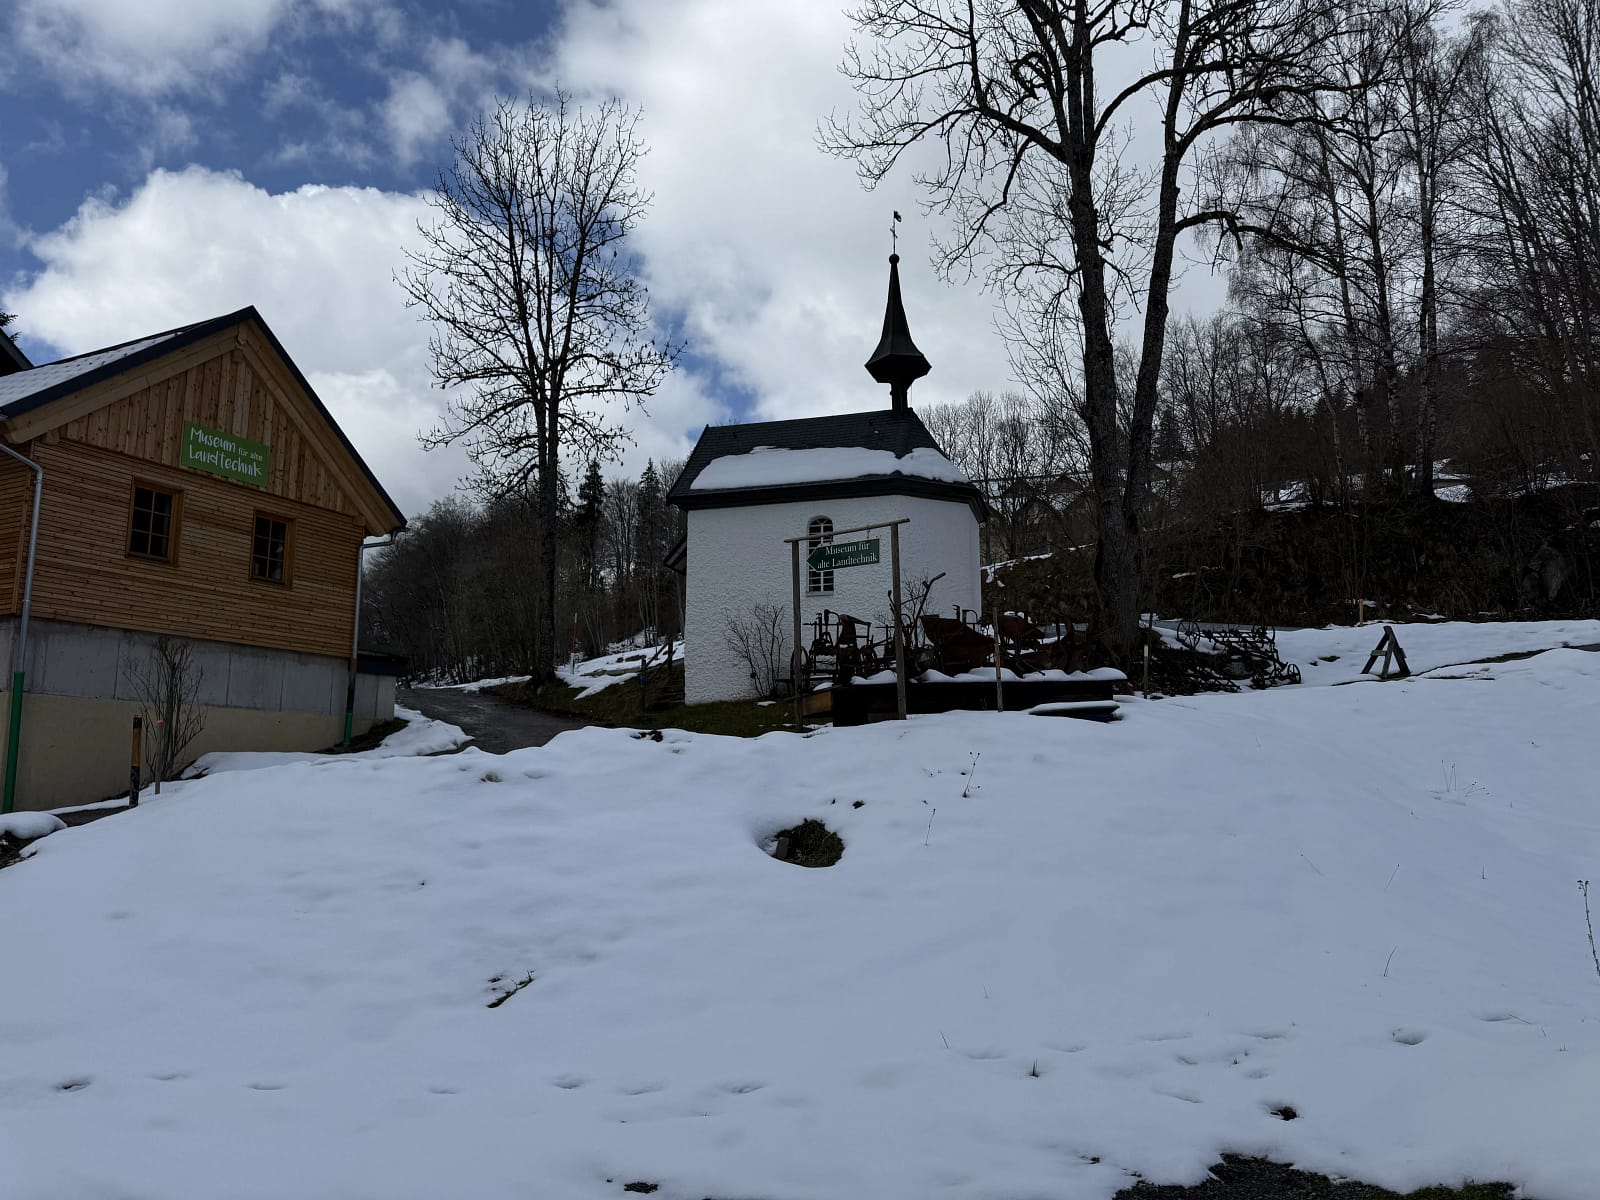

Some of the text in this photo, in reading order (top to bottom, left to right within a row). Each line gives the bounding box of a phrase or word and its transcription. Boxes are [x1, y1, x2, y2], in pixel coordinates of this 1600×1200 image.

[190, 426, 236, 453] Museum
[238, 447, 249, 457] für
[189, 443, 262, 477] Landtechnik
[817, 552, 878, 569] alte Landtechnik
[825, 541, 869, 556] Museum für
